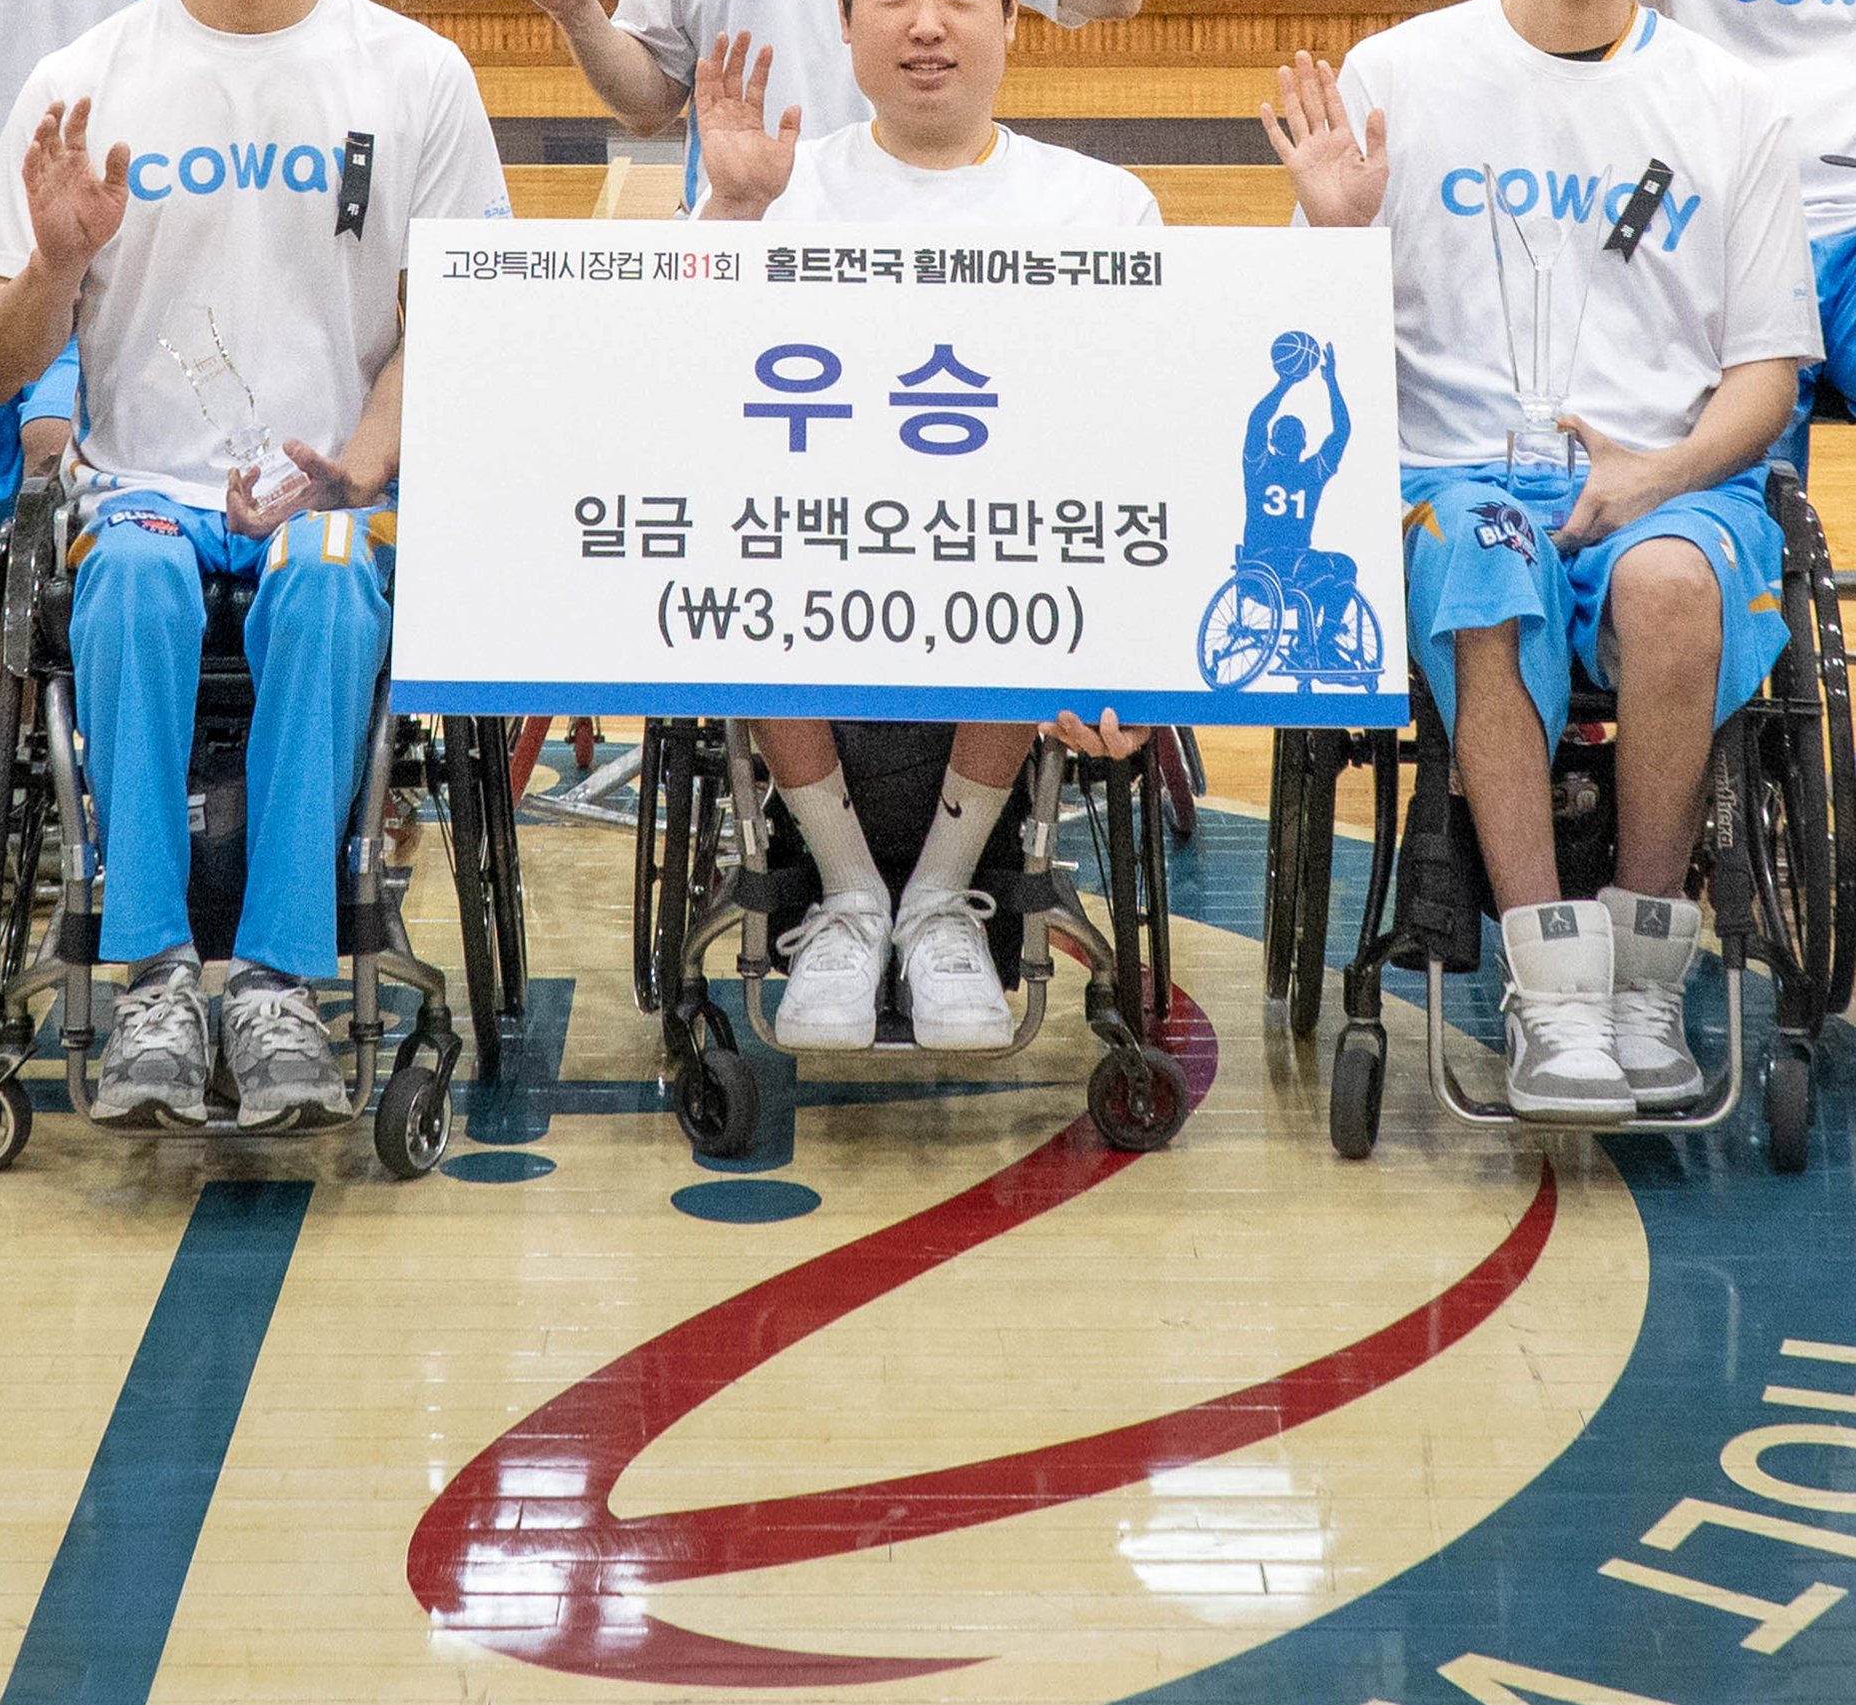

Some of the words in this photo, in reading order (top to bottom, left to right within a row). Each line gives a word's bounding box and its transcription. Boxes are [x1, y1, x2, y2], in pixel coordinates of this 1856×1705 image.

[442, 246, 644, 284] 고양특례시장컵
[653, 247, 742, 283] 제31회
[764, 245, 904, 287] 홀트전국
[912, 247, 1163, 288] 휠체어농구대회
[573, 494, 694, 561] 일금
[730, 497, 1170, 568] 삼백오십만원정
[1261, 485, 1307, 520] 31
[657, 579, 1085, 655] (₩3,500,000)
